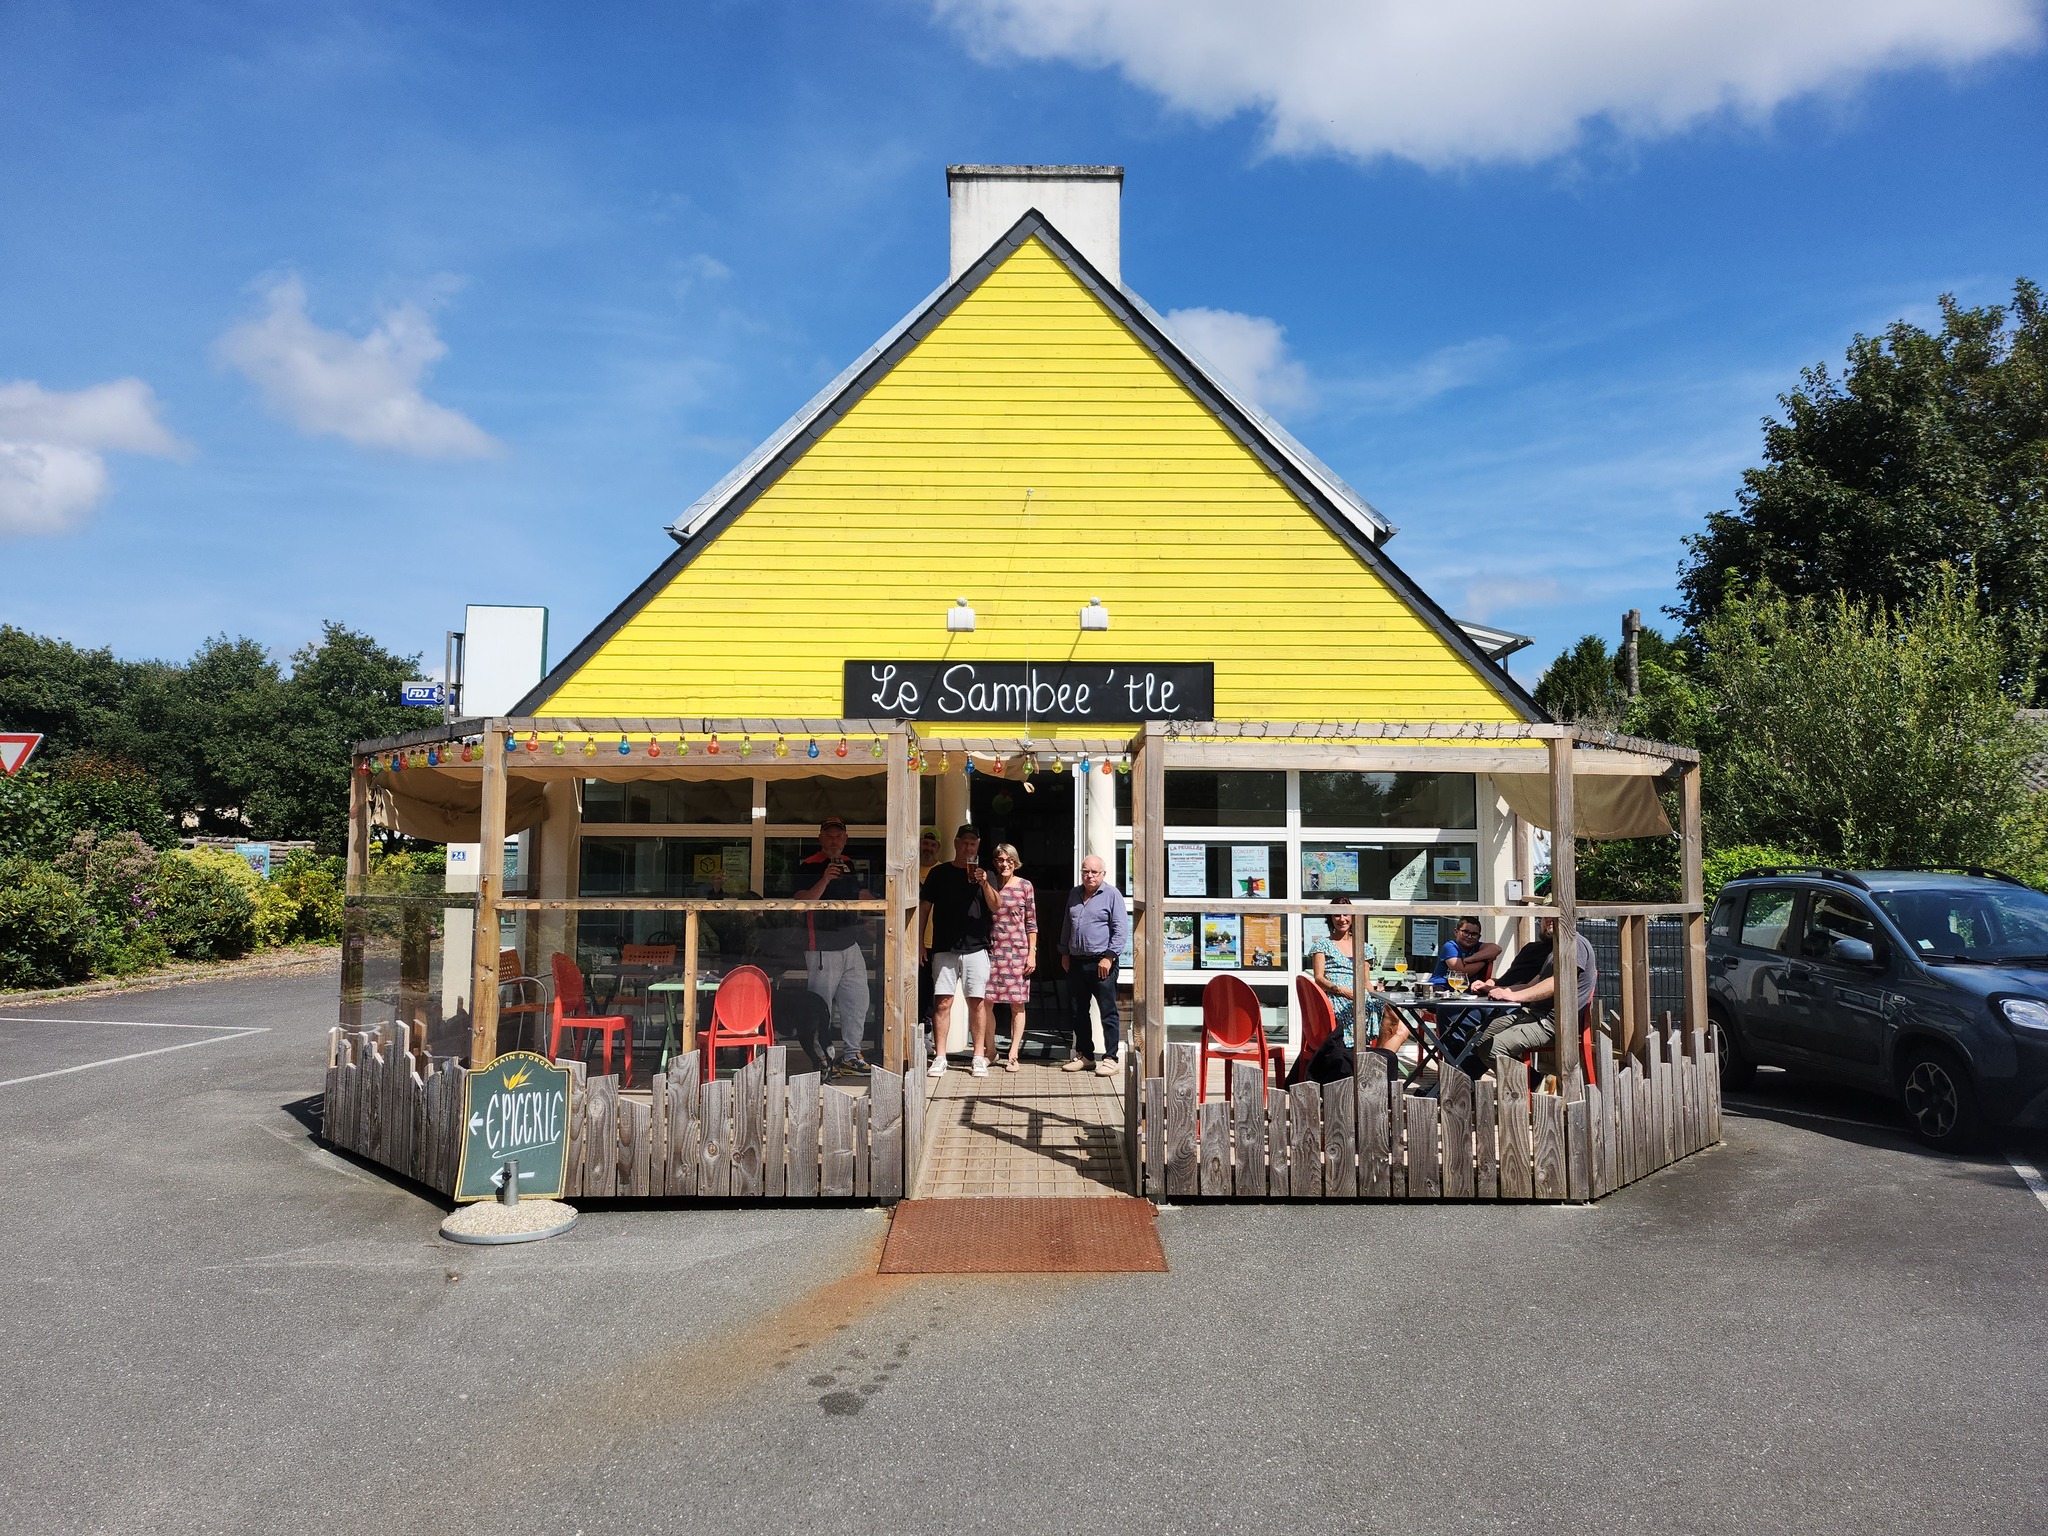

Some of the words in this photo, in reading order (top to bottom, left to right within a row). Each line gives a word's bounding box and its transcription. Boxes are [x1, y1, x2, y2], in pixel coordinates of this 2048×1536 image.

[409, 688, 430, 698] FDJ
[871, 663, 921, 715] Le
[937, 663, 1092, 715] Sambee
[453, 851, 464, 860] 24
[488, 1053, 516, 1071] GRAIN
[518, 1053, 550, 1069] D'ORGE
[486, 1089, 563, 1149] ÉPICERIE
